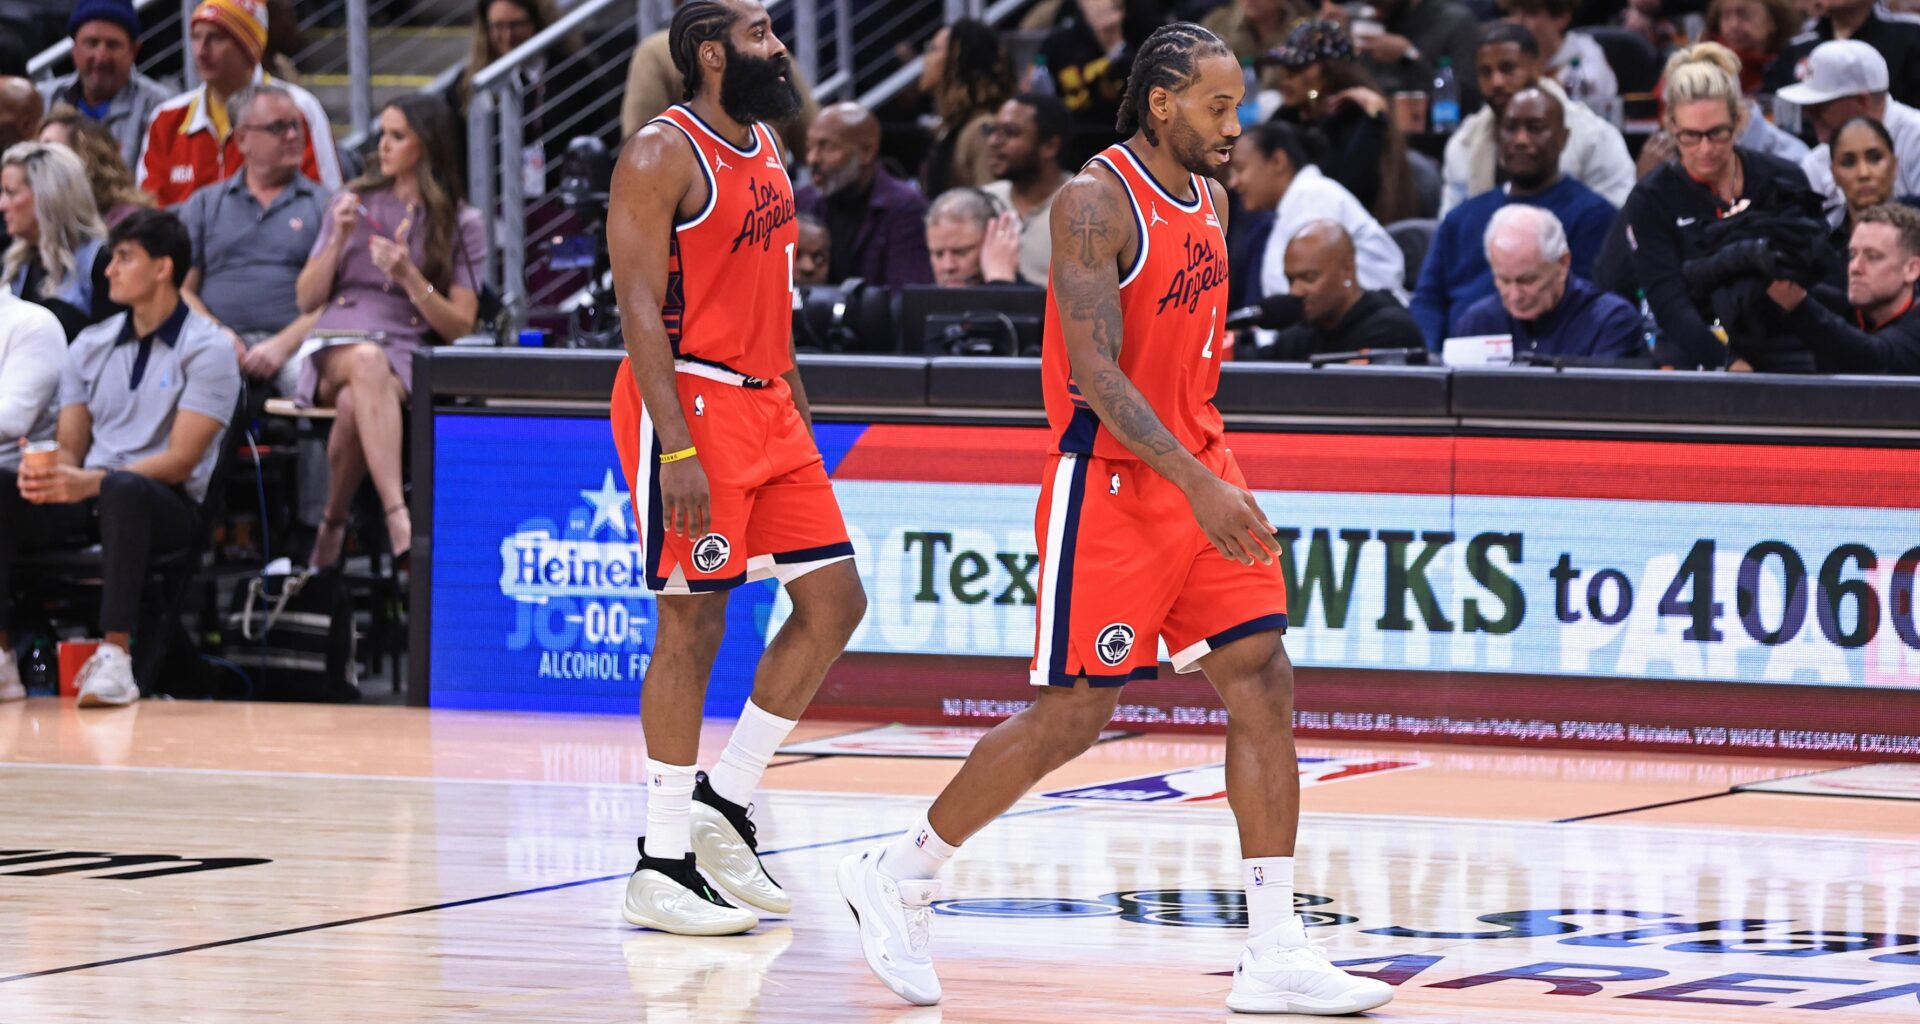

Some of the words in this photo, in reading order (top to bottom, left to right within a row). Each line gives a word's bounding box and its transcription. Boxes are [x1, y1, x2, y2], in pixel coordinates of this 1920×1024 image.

[749, 176, 780, 212] Los
[784, 242, 796, 294] 1
[1184, 232, 1214, 271] Los
[1156, 250, 1229, 316] Angeles
[1201, 306, 1217, 359] 2
[1549, 552, 1634, 626] to
[539, 651, 623, 681] ALCOHOL
[1300, 711, 1329, 730] FULL
[1332, 712, 1373, 731] RULES
[1694, 726, 1727, 746] VOID
[1728, 728, 1777, 748] WHERE
